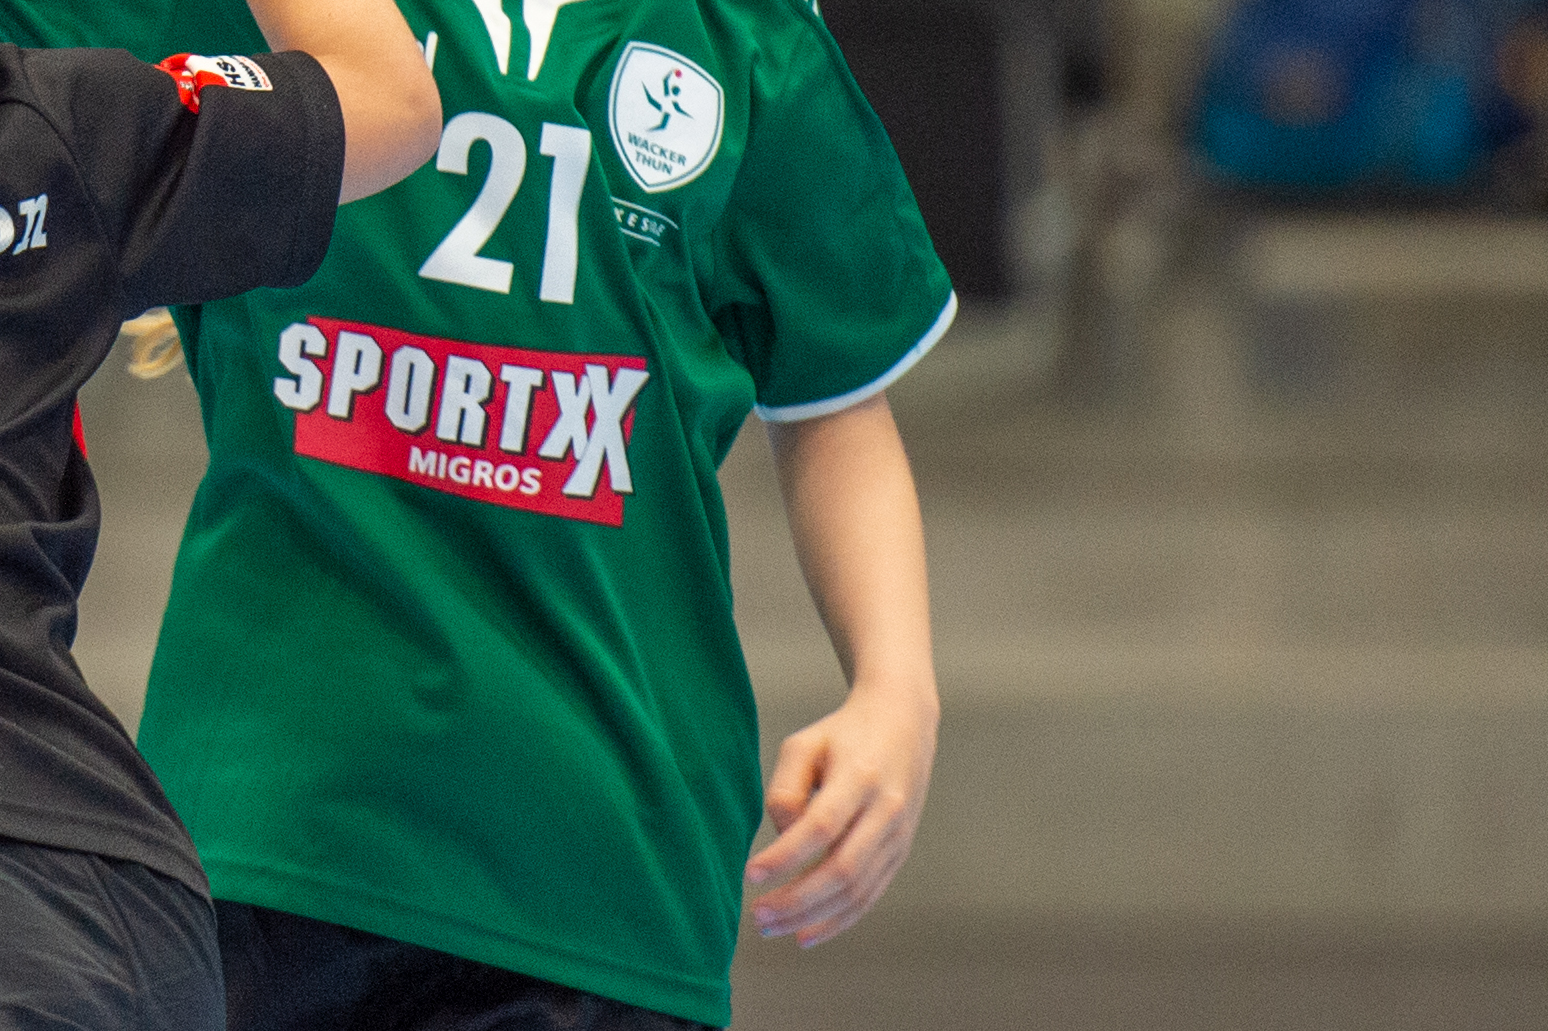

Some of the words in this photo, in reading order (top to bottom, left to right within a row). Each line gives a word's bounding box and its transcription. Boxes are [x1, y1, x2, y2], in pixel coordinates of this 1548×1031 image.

[628, 132, 687, 167] WACKER
[635, 150, 673, 176] THUN
[418, 111, 592, 304] 21
[273, 322, 650, 498] SPORTXX
[408, 446, 542, 496] MIGROS
